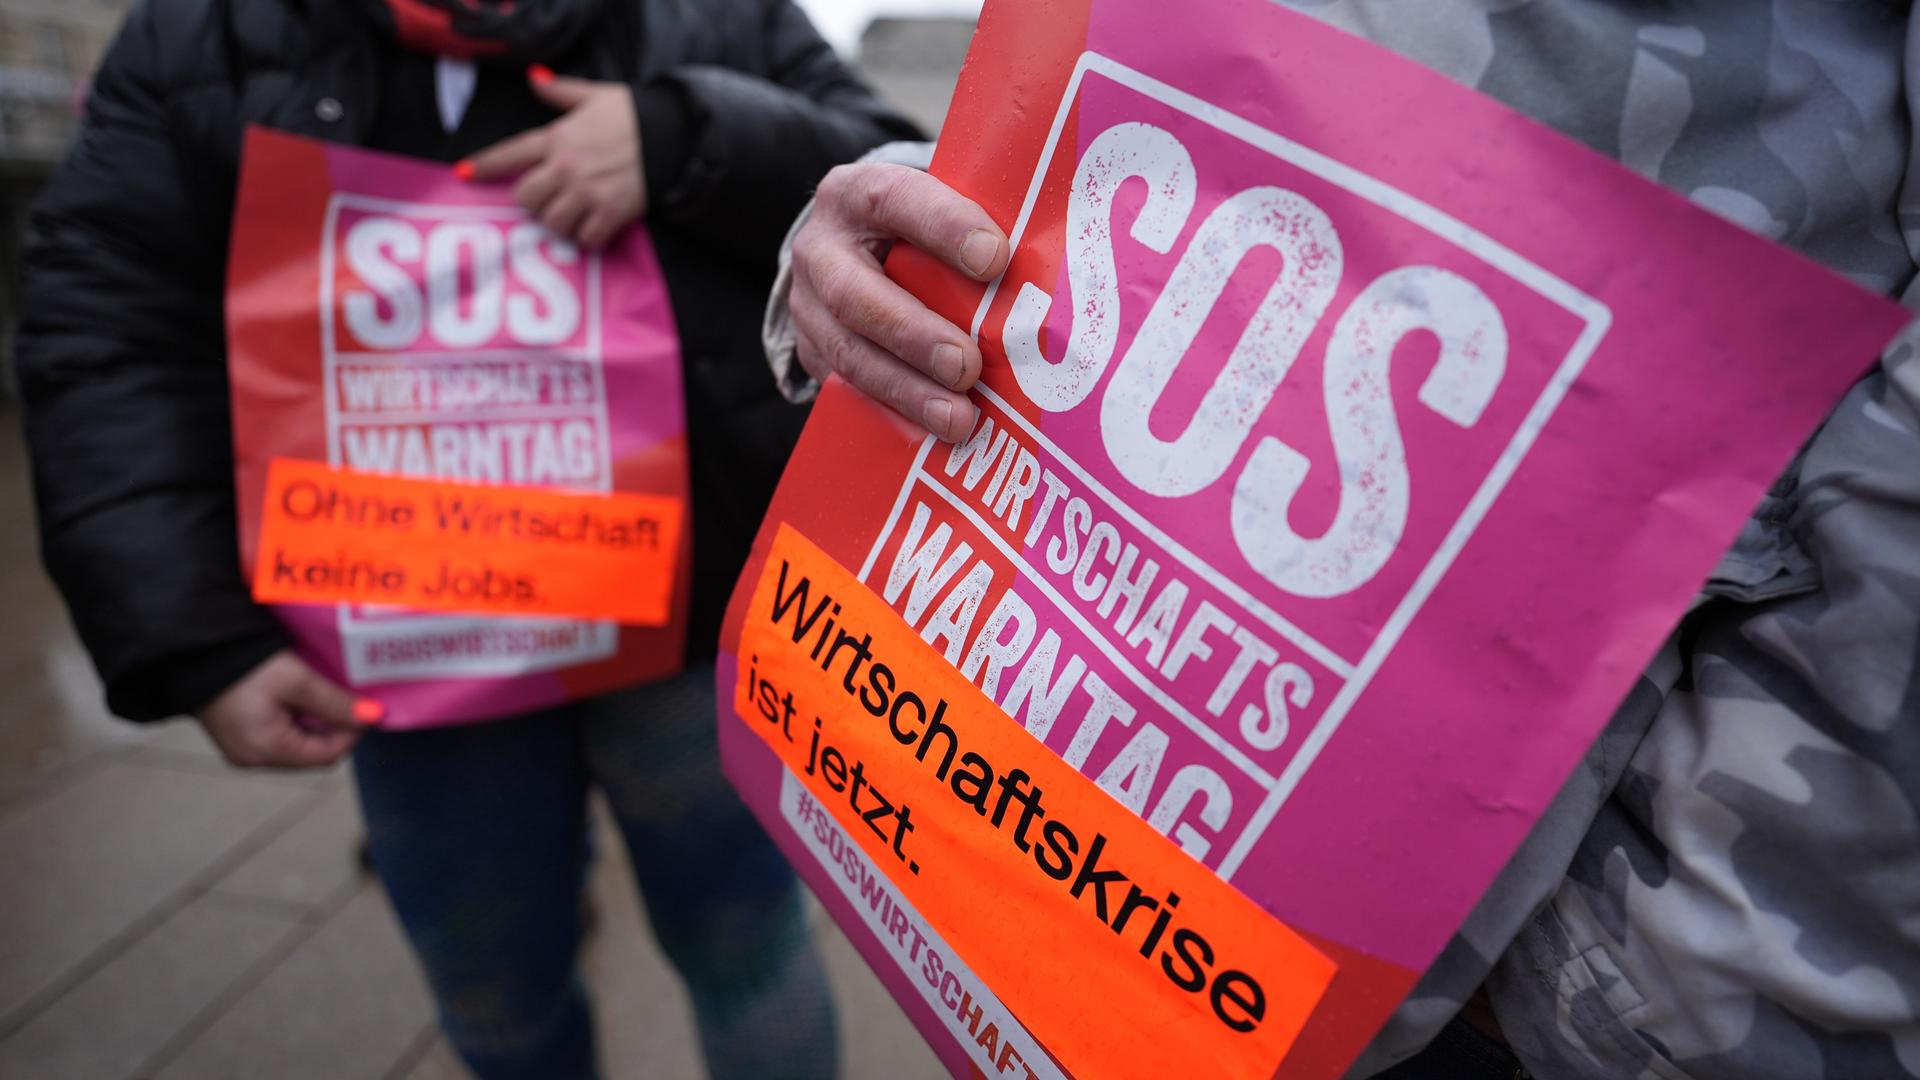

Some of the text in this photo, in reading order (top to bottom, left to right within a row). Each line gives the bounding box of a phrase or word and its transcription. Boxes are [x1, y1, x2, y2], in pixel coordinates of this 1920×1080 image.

[343, 215, 582, 349] SOS
[1003, 121, 1509, 598] SOS
[280, 478, 661, 549] Ohne Wirtschaft
[343, 420, 595, 483] WARNTAG
[273, 549, 548, 604] keine Jobs.
[882, 501, 1234, 864] WARNTAG
[943, 407, 1315, 752] WIRTSCHAFTS
[746, 655, 921, 876] ist jetzt.
[769, 559, 1267, 1034] Wirtschaftskrise
